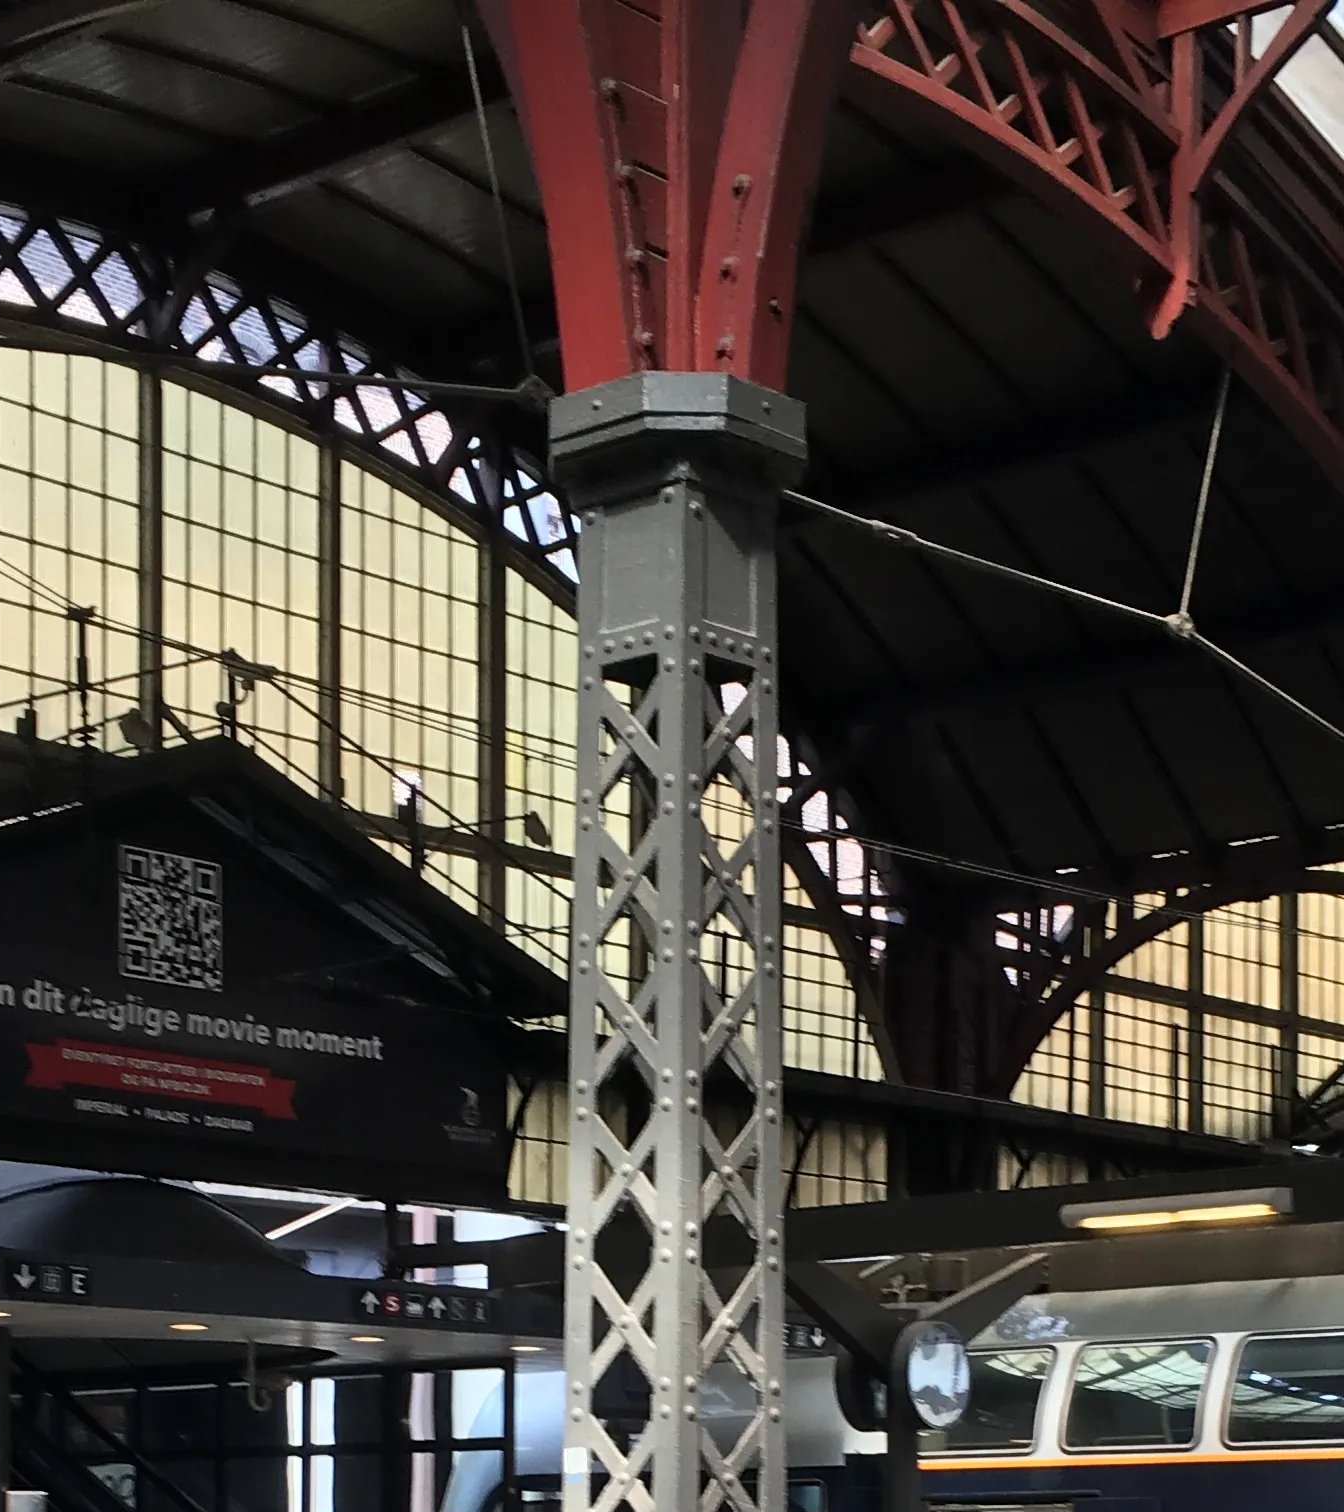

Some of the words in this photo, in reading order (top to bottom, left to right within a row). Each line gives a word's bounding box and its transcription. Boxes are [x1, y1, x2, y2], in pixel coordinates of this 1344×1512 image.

[22, 978, 65, 1015] dit
[70, 986, 181, 1038] daglige
[186, 1012, 273, 1045] movie
[276, 1024, 385, 1061] moment
[71, 1273, 87, 1295] E
[384, 1295, 401, 1313] S
